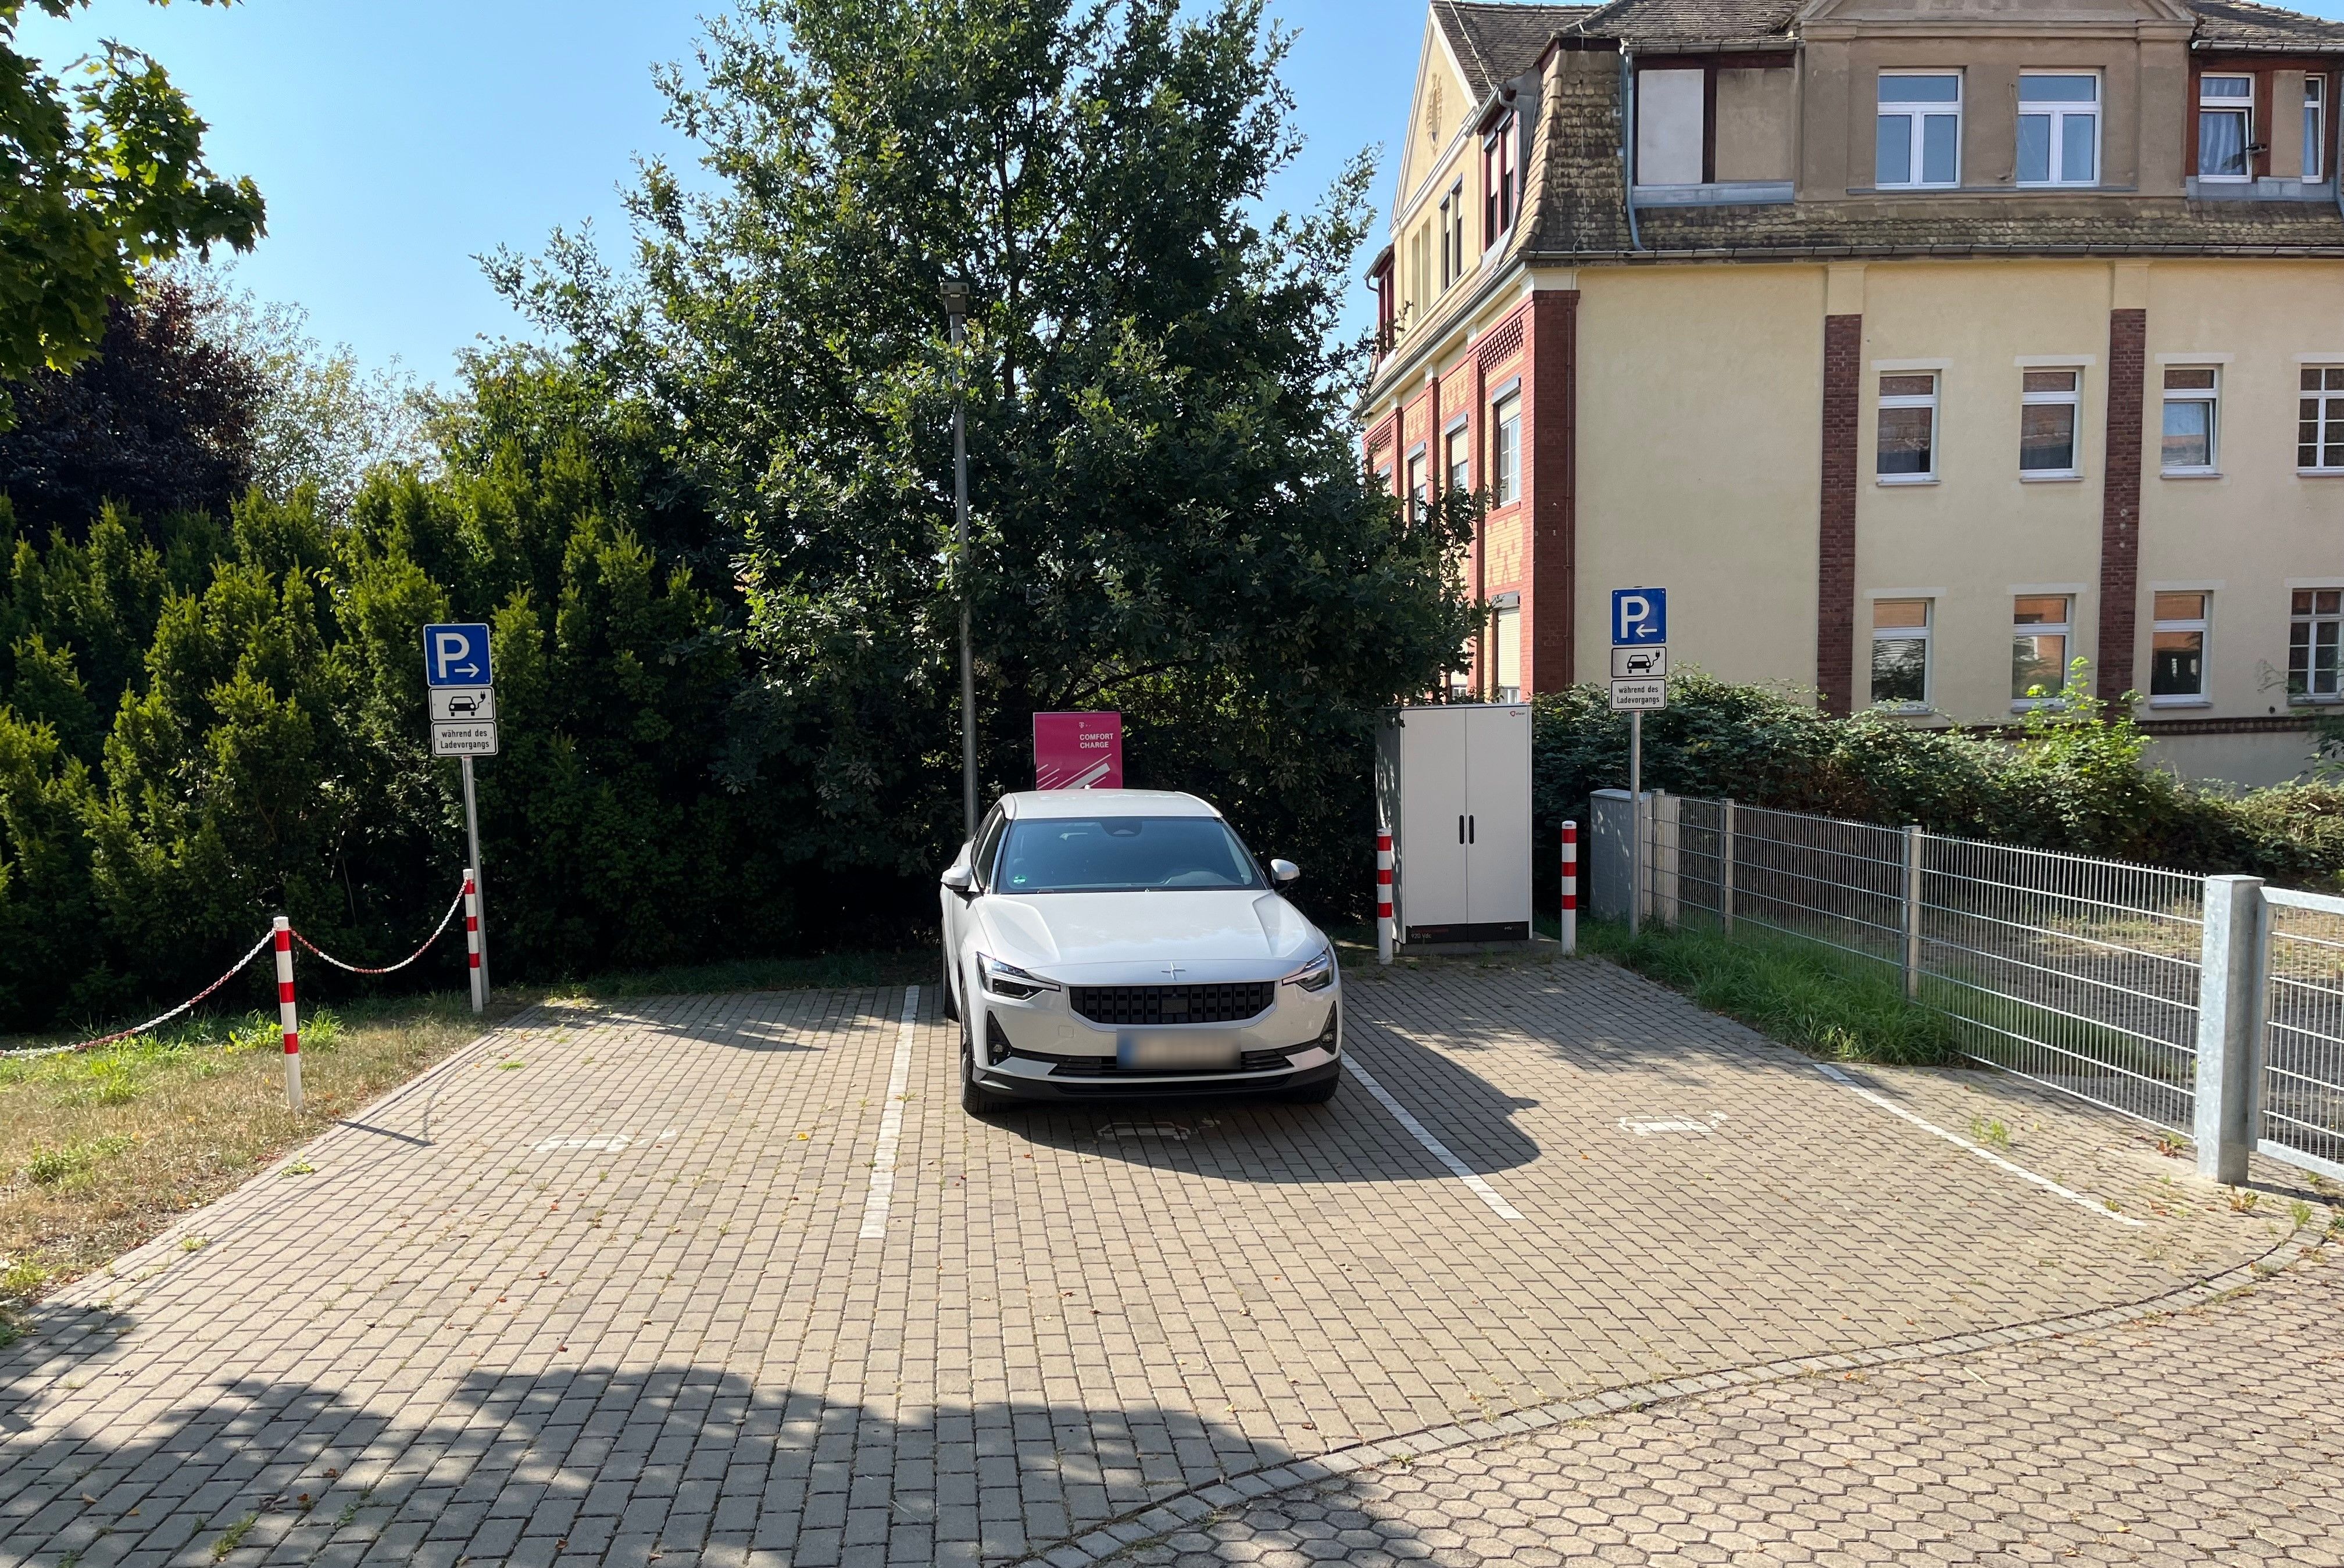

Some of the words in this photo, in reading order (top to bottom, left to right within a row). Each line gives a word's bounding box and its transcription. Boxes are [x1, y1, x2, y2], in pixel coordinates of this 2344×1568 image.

[1620, 595, 1650, 639] P
[435, 632, 470, 678] P
[1618, 685, 1645, 693] während
[1648, 685, 1659, 693] des
[1617, 696, 1660, 705] Ladevorgangs
[441, 729, 471, 738] während
[475, 729, 487, 737] des
[440, 740, 489, 750] Ladevorgangs
[1080, 741, 1109, 749] CHARGE
